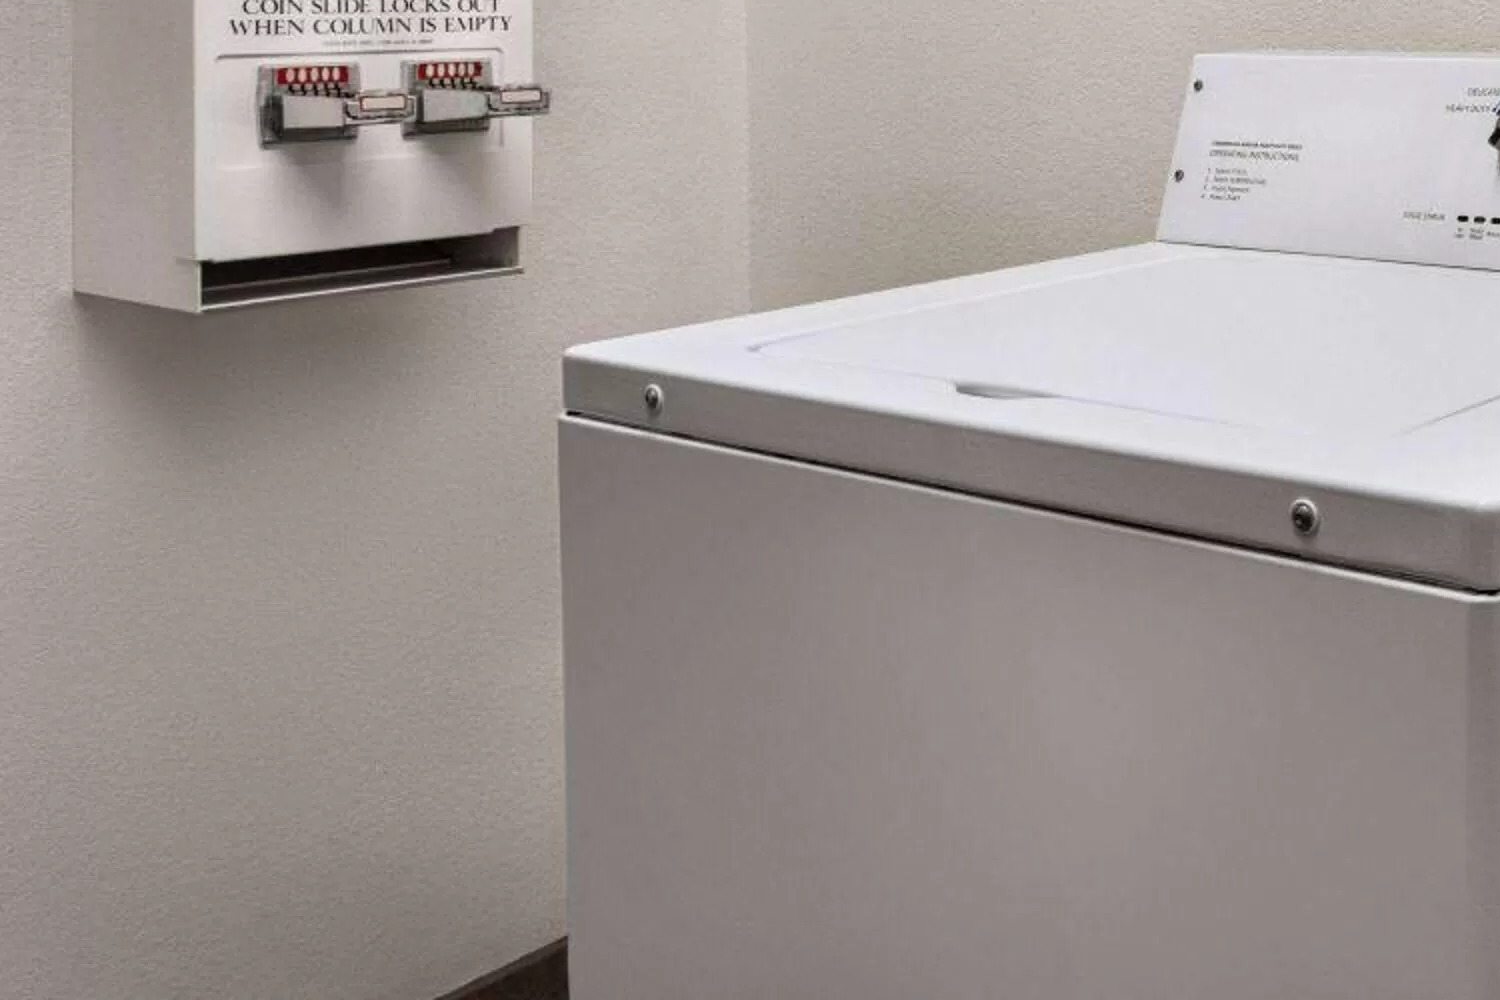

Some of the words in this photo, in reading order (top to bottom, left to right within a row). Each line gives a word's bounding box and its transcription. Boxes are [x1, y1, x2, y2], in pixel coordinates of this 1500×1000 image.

[229, 18, 304, 36] WHEN
[313, 16, 411, 34] COLUMN
[420, 16, 437, 33] IS
[444, 15, 512, 32] EMPTY
